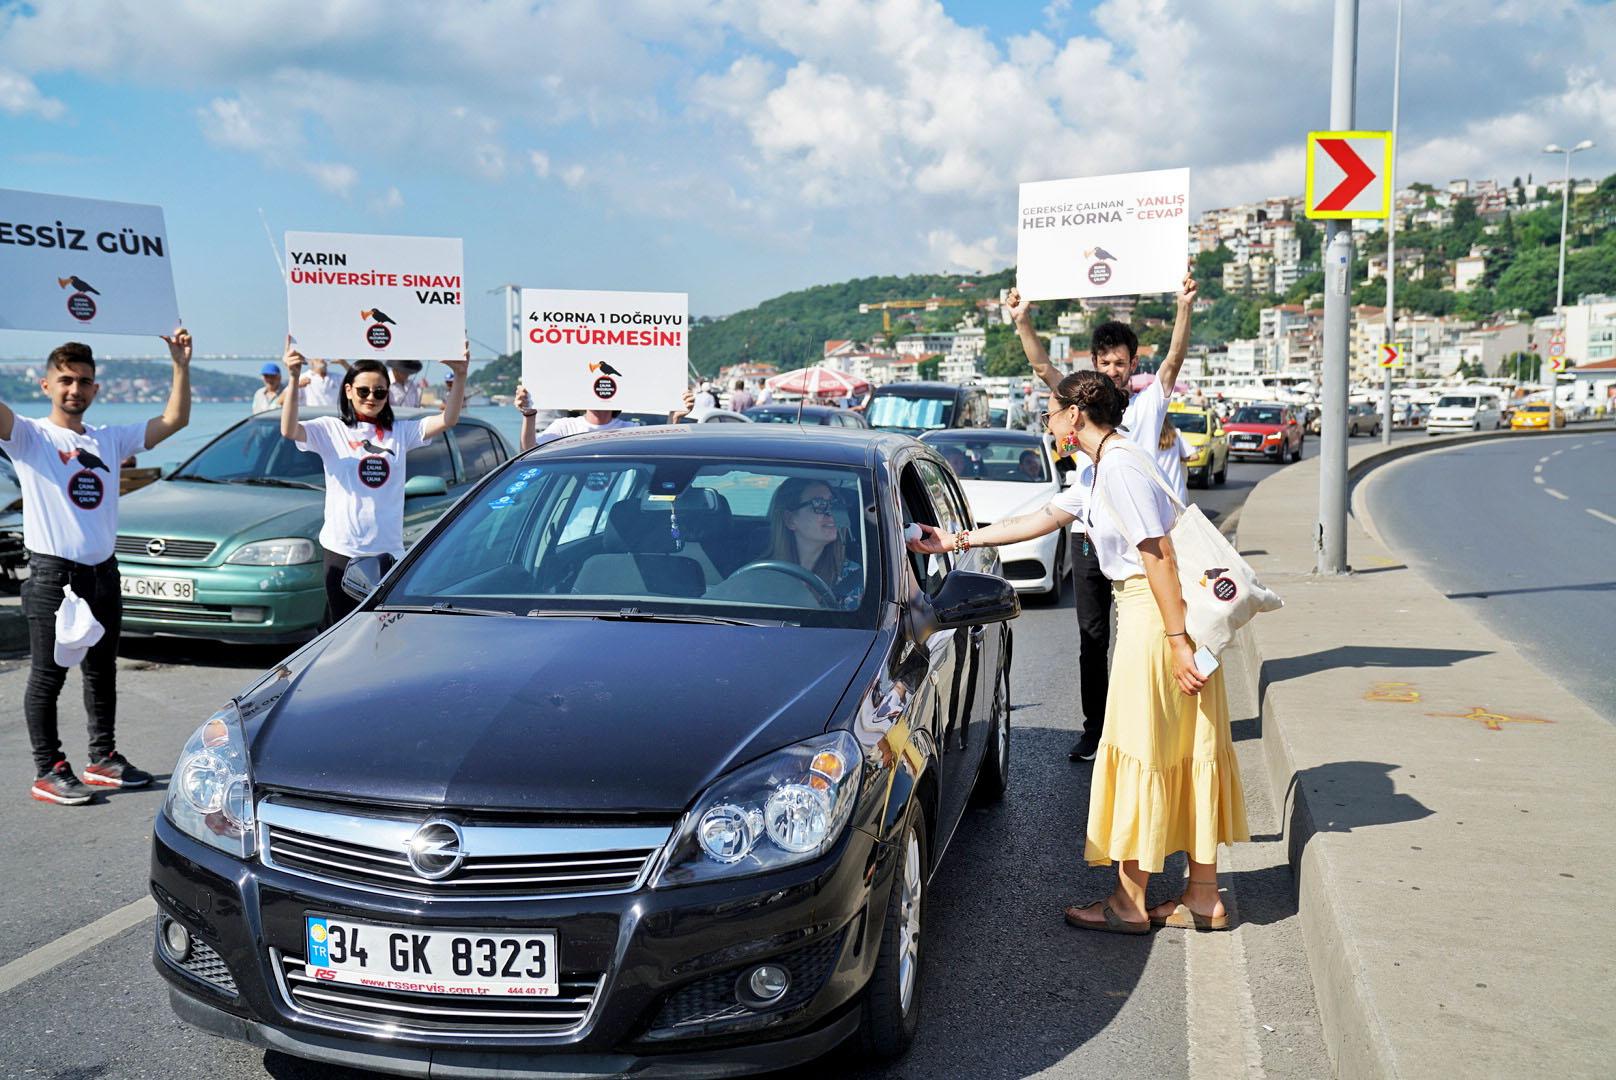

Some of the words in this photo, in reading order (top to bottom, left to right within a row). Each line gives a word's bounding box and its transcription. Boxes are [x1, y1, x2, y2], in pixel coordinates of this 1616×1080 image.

[1023, 203, 1073, 215] GEREKSİZ
[1076, 200, 1124, 211] ÇALINAN
[1136, 194, 1185, 207] YANLIŞ
[1023, 216, 1056, 229] HER
[1061, 210, 1122, 226] KORNA
[1137, 207, 1183, 220] CEVAP
[0, 220, 88, 251] ESSİZ
[96, 228, 164, 257] GÜN
[291, 252, 347, 266] YARIN
[291, 267, 398, 287] ÜNİVERSİTE
[403, 274, 461, 288] SINAVI
[416, 290, 461, 305] VAR!
[529, 312, 538, 322] 4
[543, 312, 596, 323] KORNA
[600, 313, 605, 323] 1
[610, 311, 682, 325] DOĞRUYU
[529, 324, 681, 347] GÖTÜRMESİN!
[136, 580, 167, 597] GNK
[173, 582, 191, 598] 98
[312, 945, 327, 958] TR
[328, 925, 368, 967] 34
[389, 933, 432, 975] GK
[451, 937, 547, 979] 8323
[314, 968, 337, 980] RS
[360, 978, 490, 995] www.rsservis.com.tr
[537, 987, 549, 995] 77
